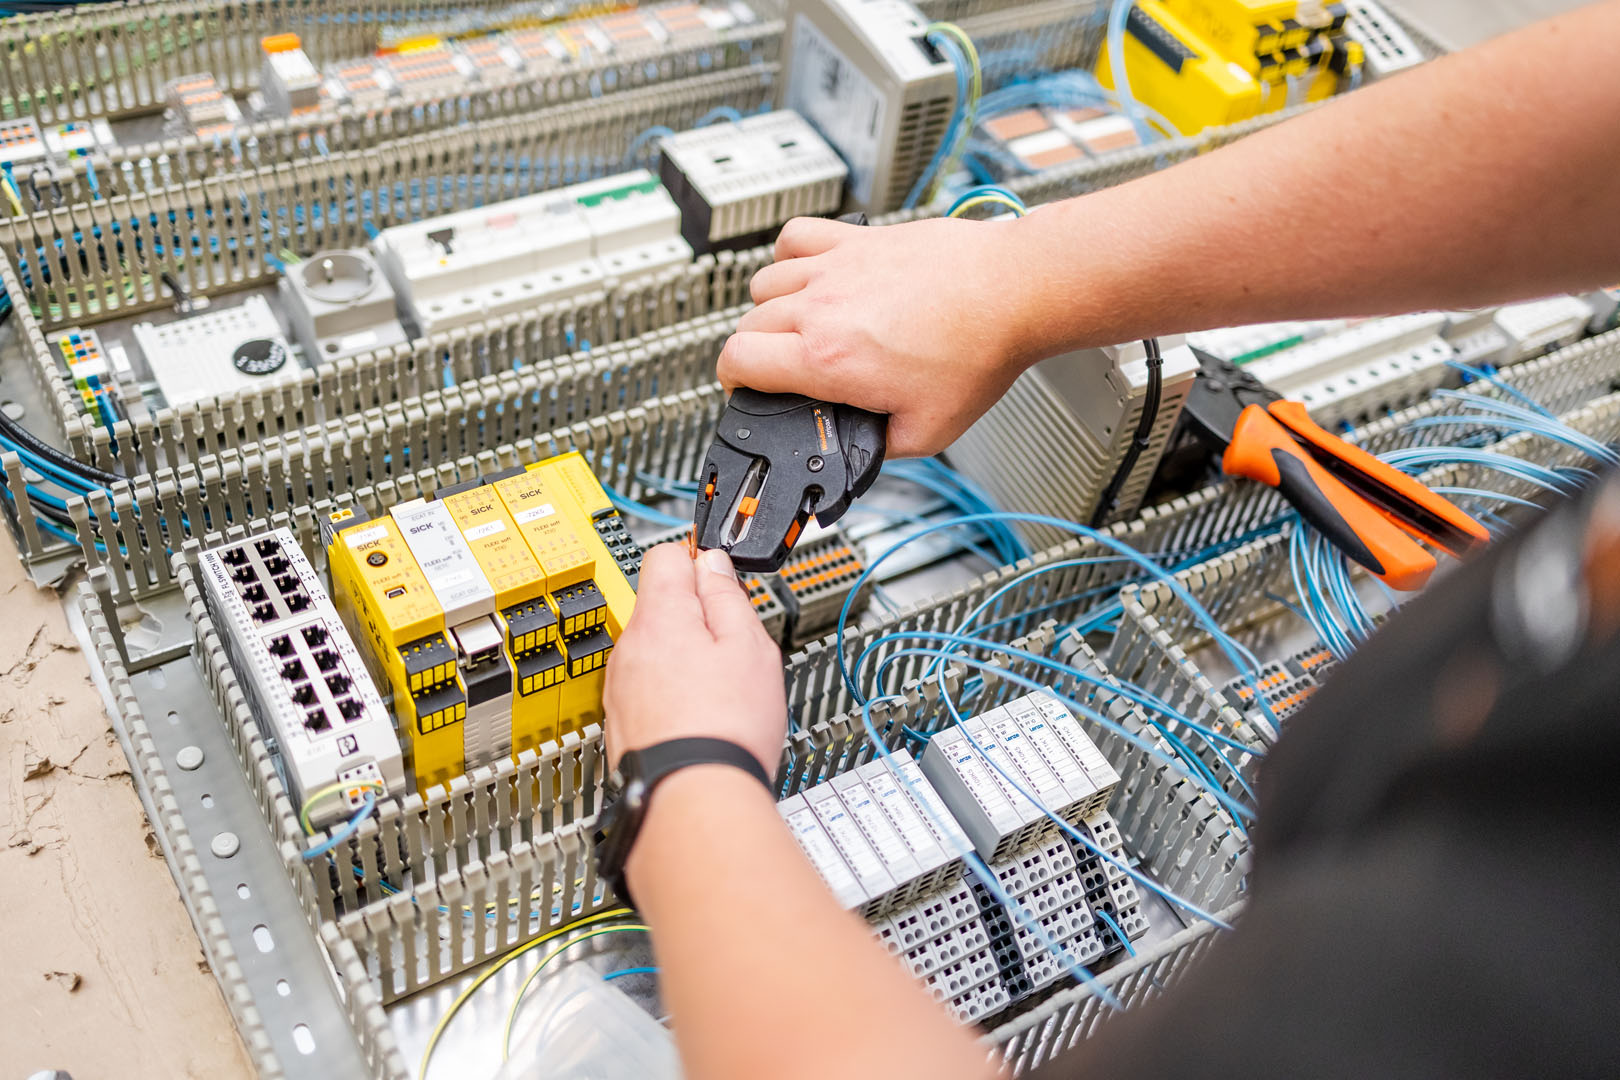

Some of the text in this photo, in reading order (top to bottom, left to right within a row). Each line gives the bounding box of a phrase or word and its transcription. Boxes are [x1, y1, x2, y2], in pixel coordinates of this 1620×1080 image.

[520, 488, 542, 500] SICK
[470, 504, 494, 516] SICK
[410, 522, 434, 534] SICK
[357, 540, 381, 552] SICK
[211, 563, 226, 583] SWITCH
[1029, 724, 1044, 732] Lenze
[1005, 733, 1020, 742] Lenze
[829, 812, 844, 822] Lenze
